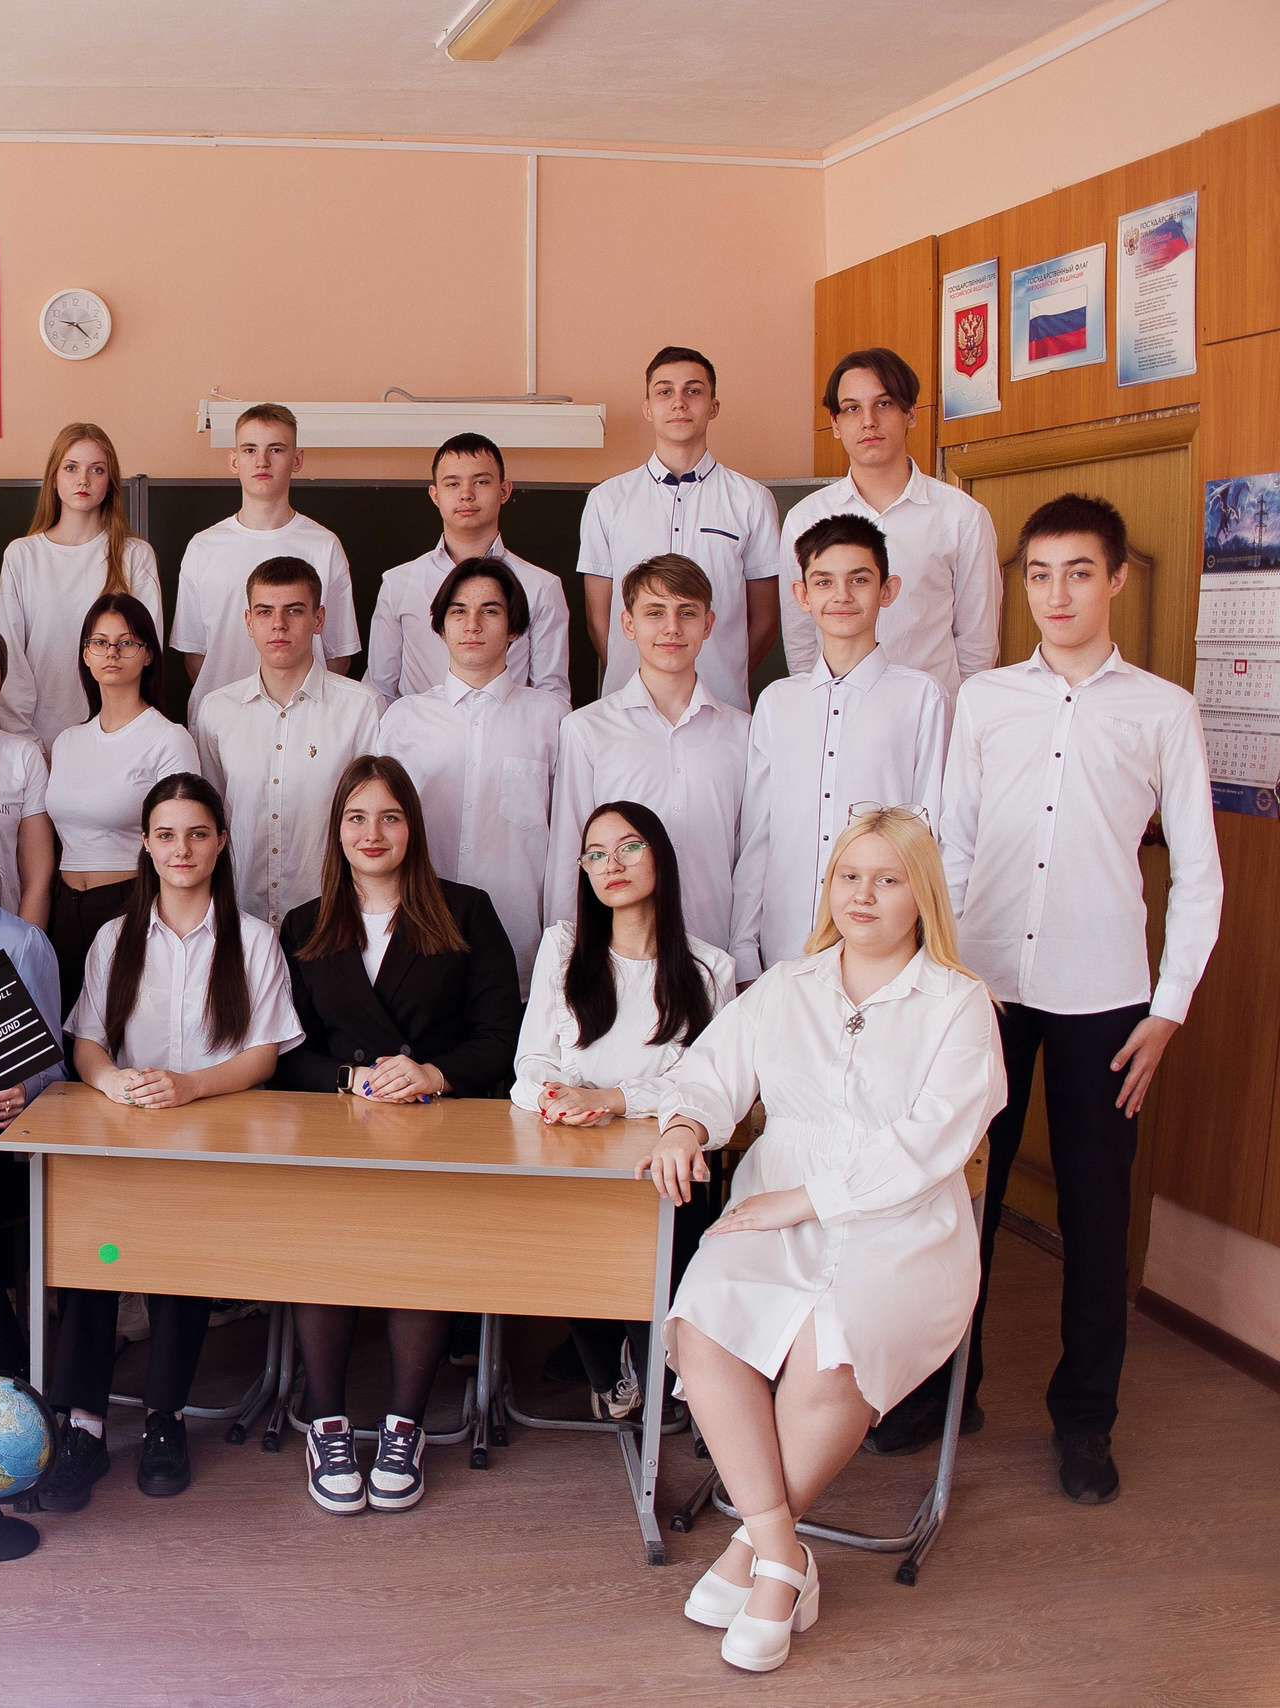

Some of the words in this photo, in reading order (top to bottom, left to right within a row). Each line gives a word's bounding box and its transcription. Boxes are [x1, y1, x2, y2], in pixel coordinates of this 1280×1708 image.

[1028, 264, 1074, 284] ГОСУДАРСТВЕННЫЙ
[1075, 260, 1088, 270] ФЛАГ
[61, 340, 66, 349] 7
[85, 340, 90, 348] 5
